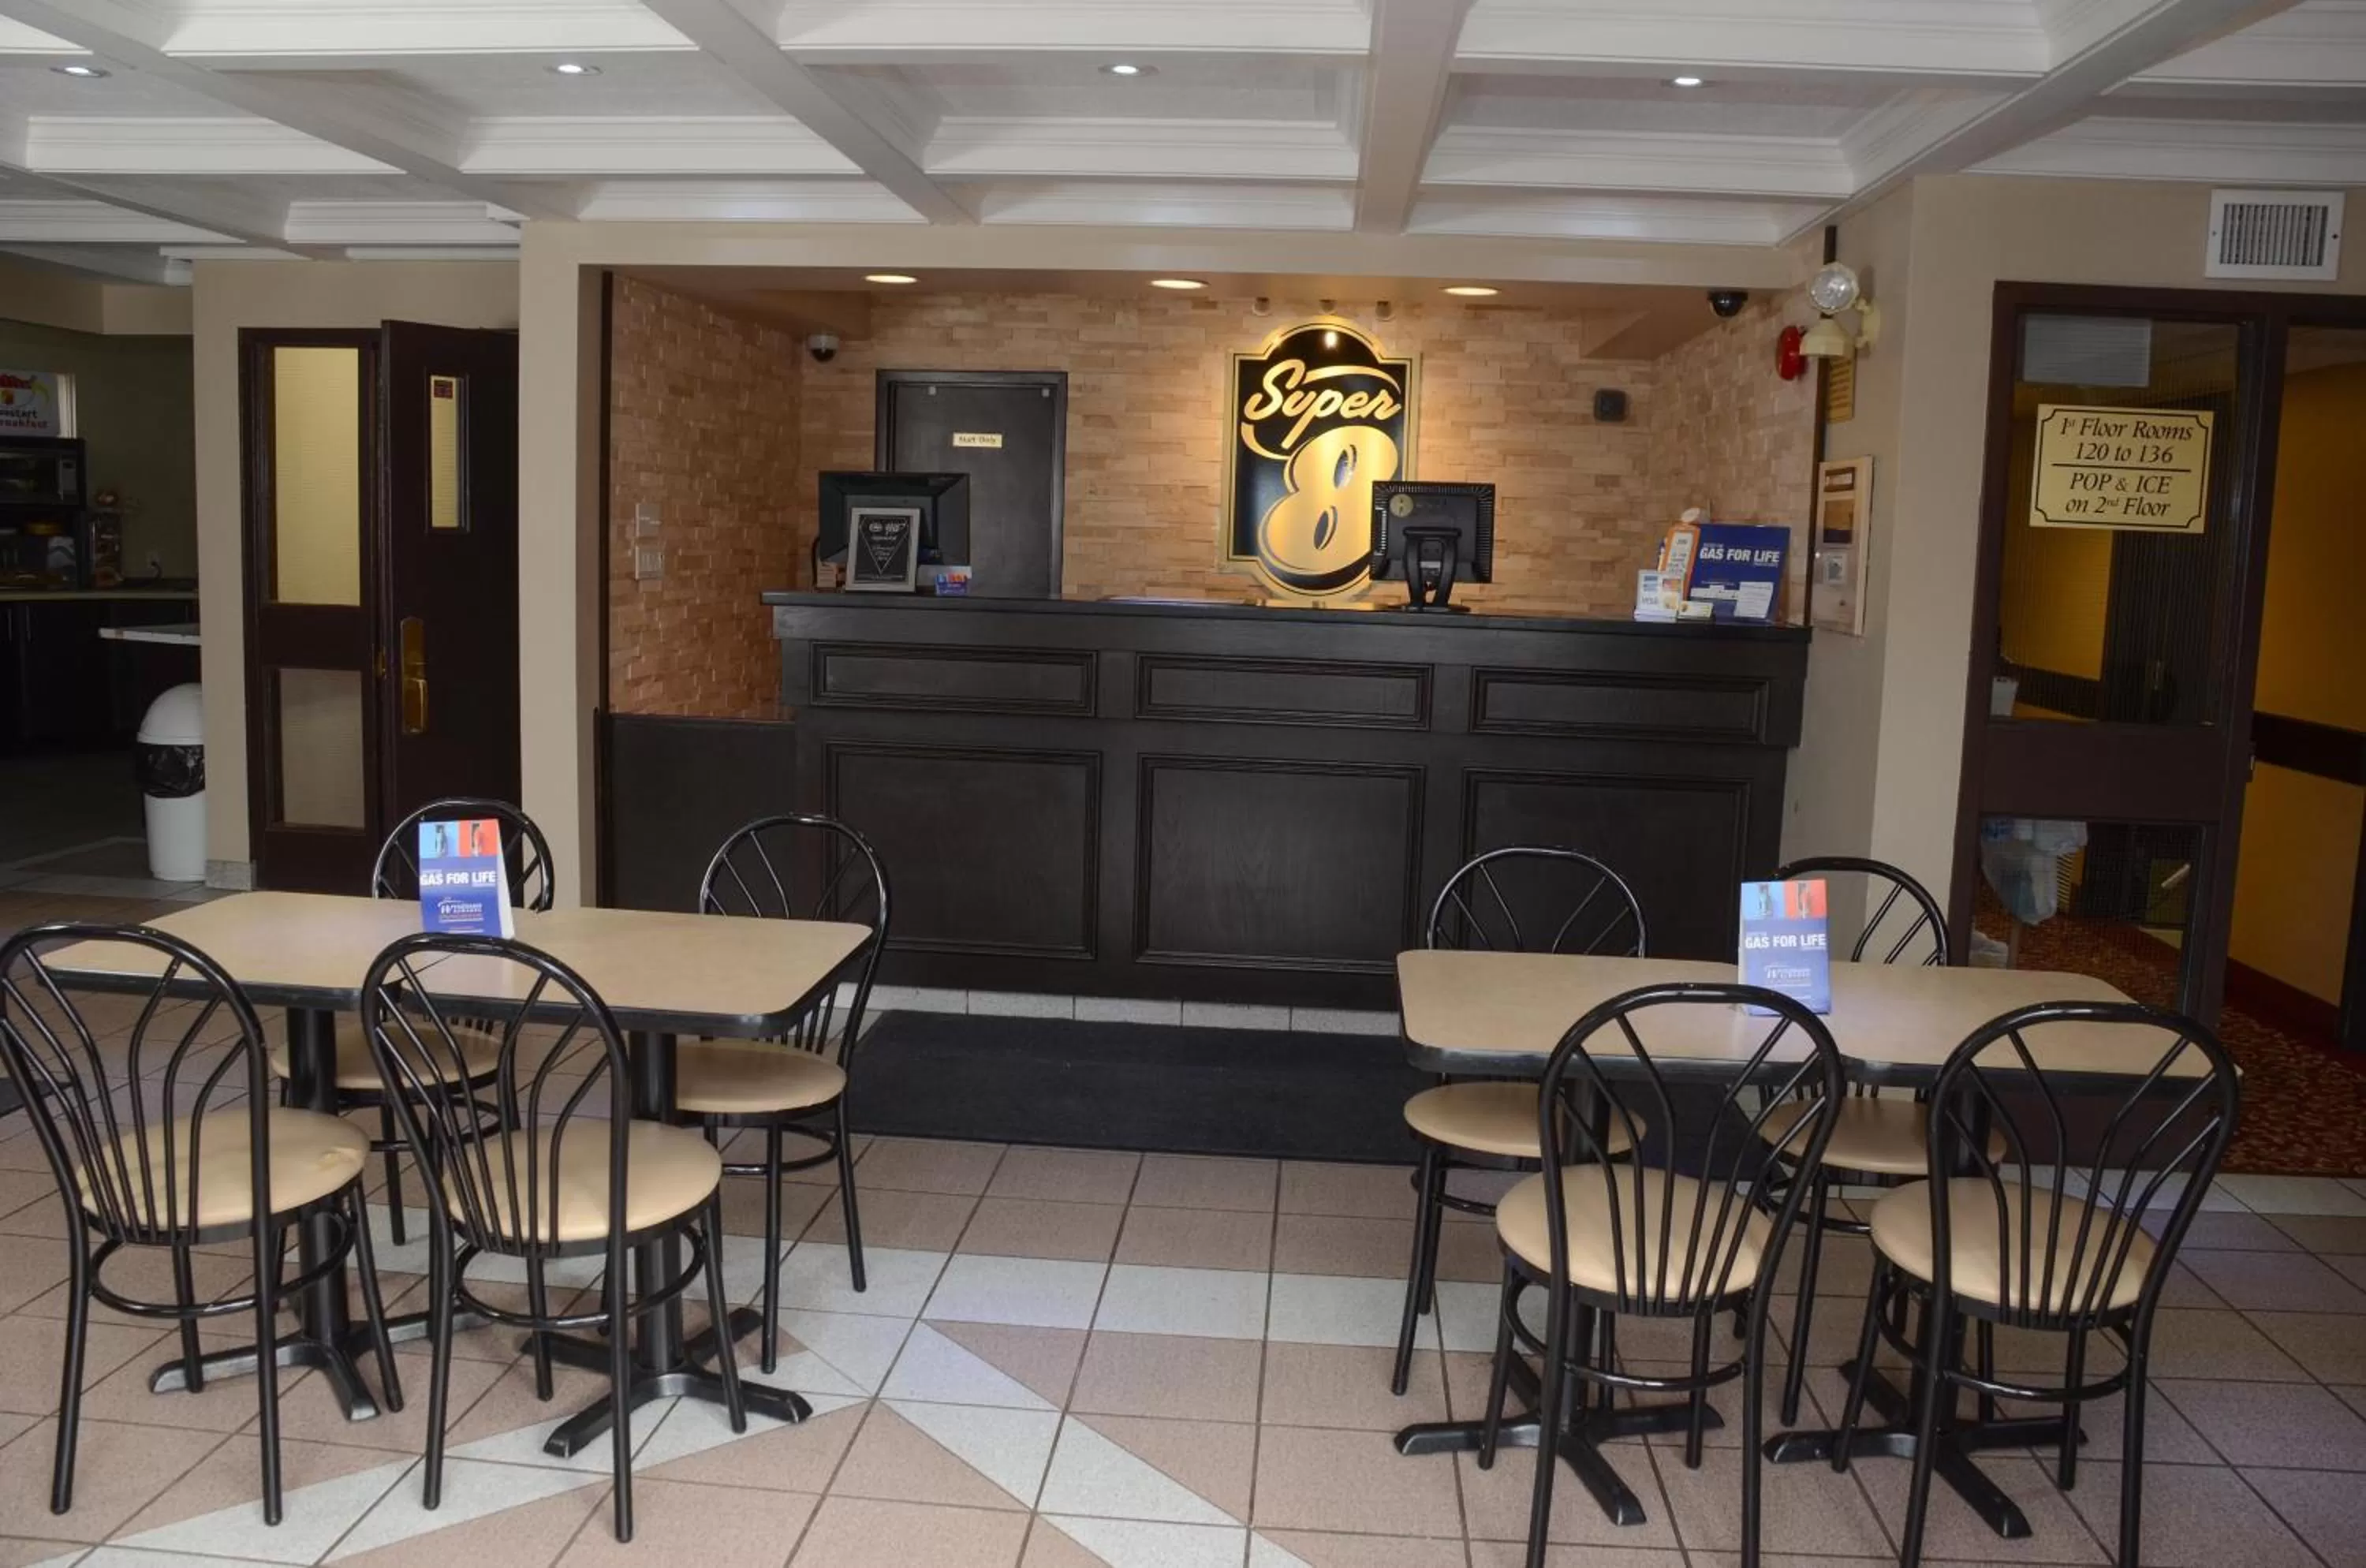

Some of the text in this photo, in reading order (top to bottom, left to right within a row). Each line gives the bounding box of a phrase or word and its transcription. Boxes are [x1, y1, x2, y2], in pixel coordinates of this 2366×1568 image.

[1244, 359, 1401, 450] Super
[2080, 418, 2128, 439] Floor
[2133, 420, 2193, 441] Rooms
[2075, 442, 2174, 464] 120 to 136
[2069, 472, 2174, 494] POP & ICE
[1259, 424, 1399, 575] 8
[2065, 498, 2088, 513] on
[2123, 496, 2171, 517] Floor
[1700, 547, 1780, 563] GAS FOR LIFE
[420, 870, 496, 886] GAS FOR LIFE
[1745, 933, 1827, 949] GAS FOR LIFE
